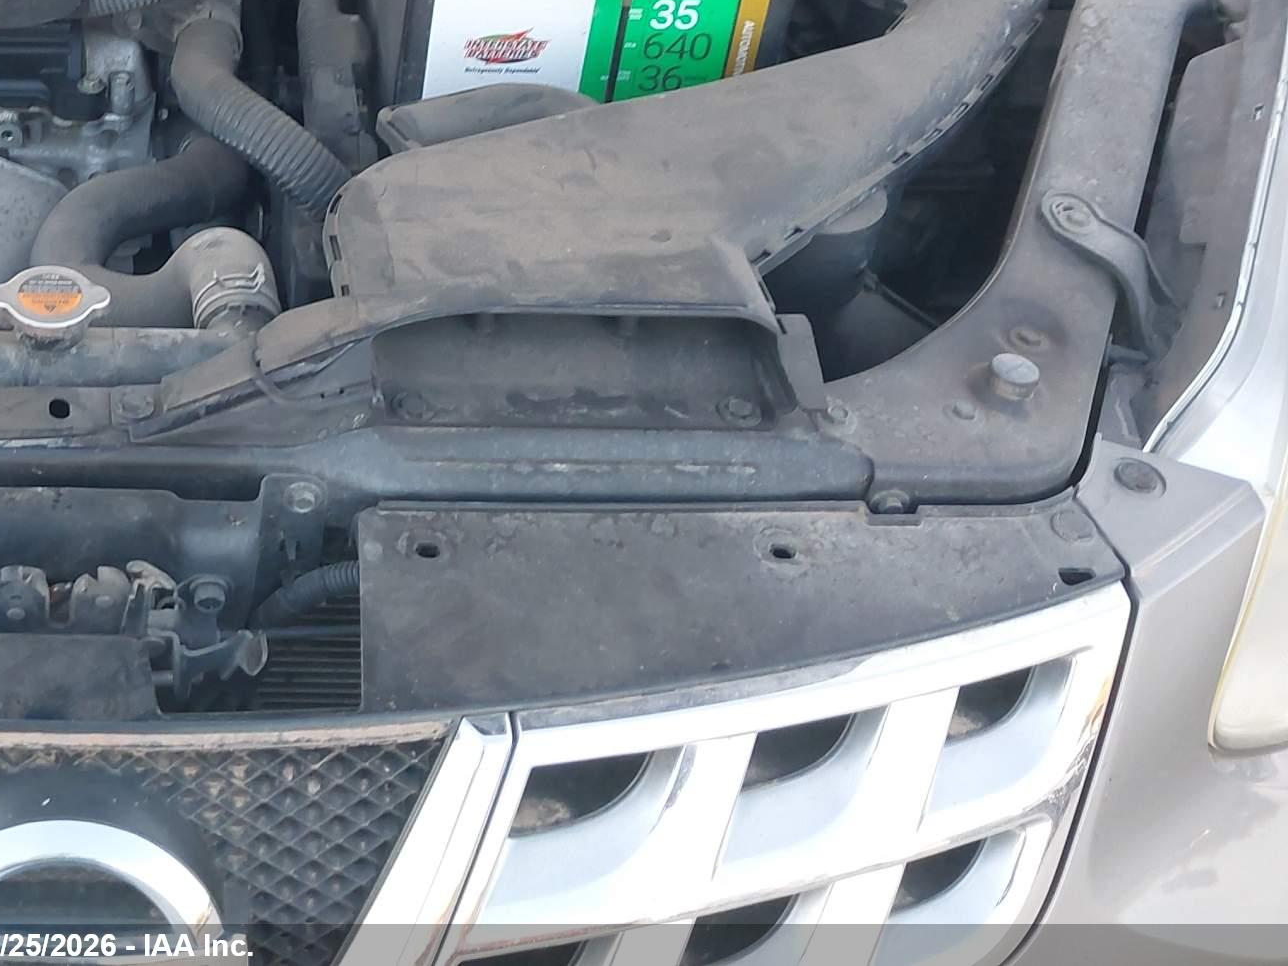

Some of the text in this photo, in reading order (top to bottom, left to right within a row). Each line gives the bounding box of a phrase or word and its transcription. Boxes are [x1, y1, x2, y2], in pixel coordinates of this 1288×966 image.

[643, 32, 713, 61] 640
[733, 20, 756, 76] AUTOMOTI
[638, 65, 682, 92] 36
